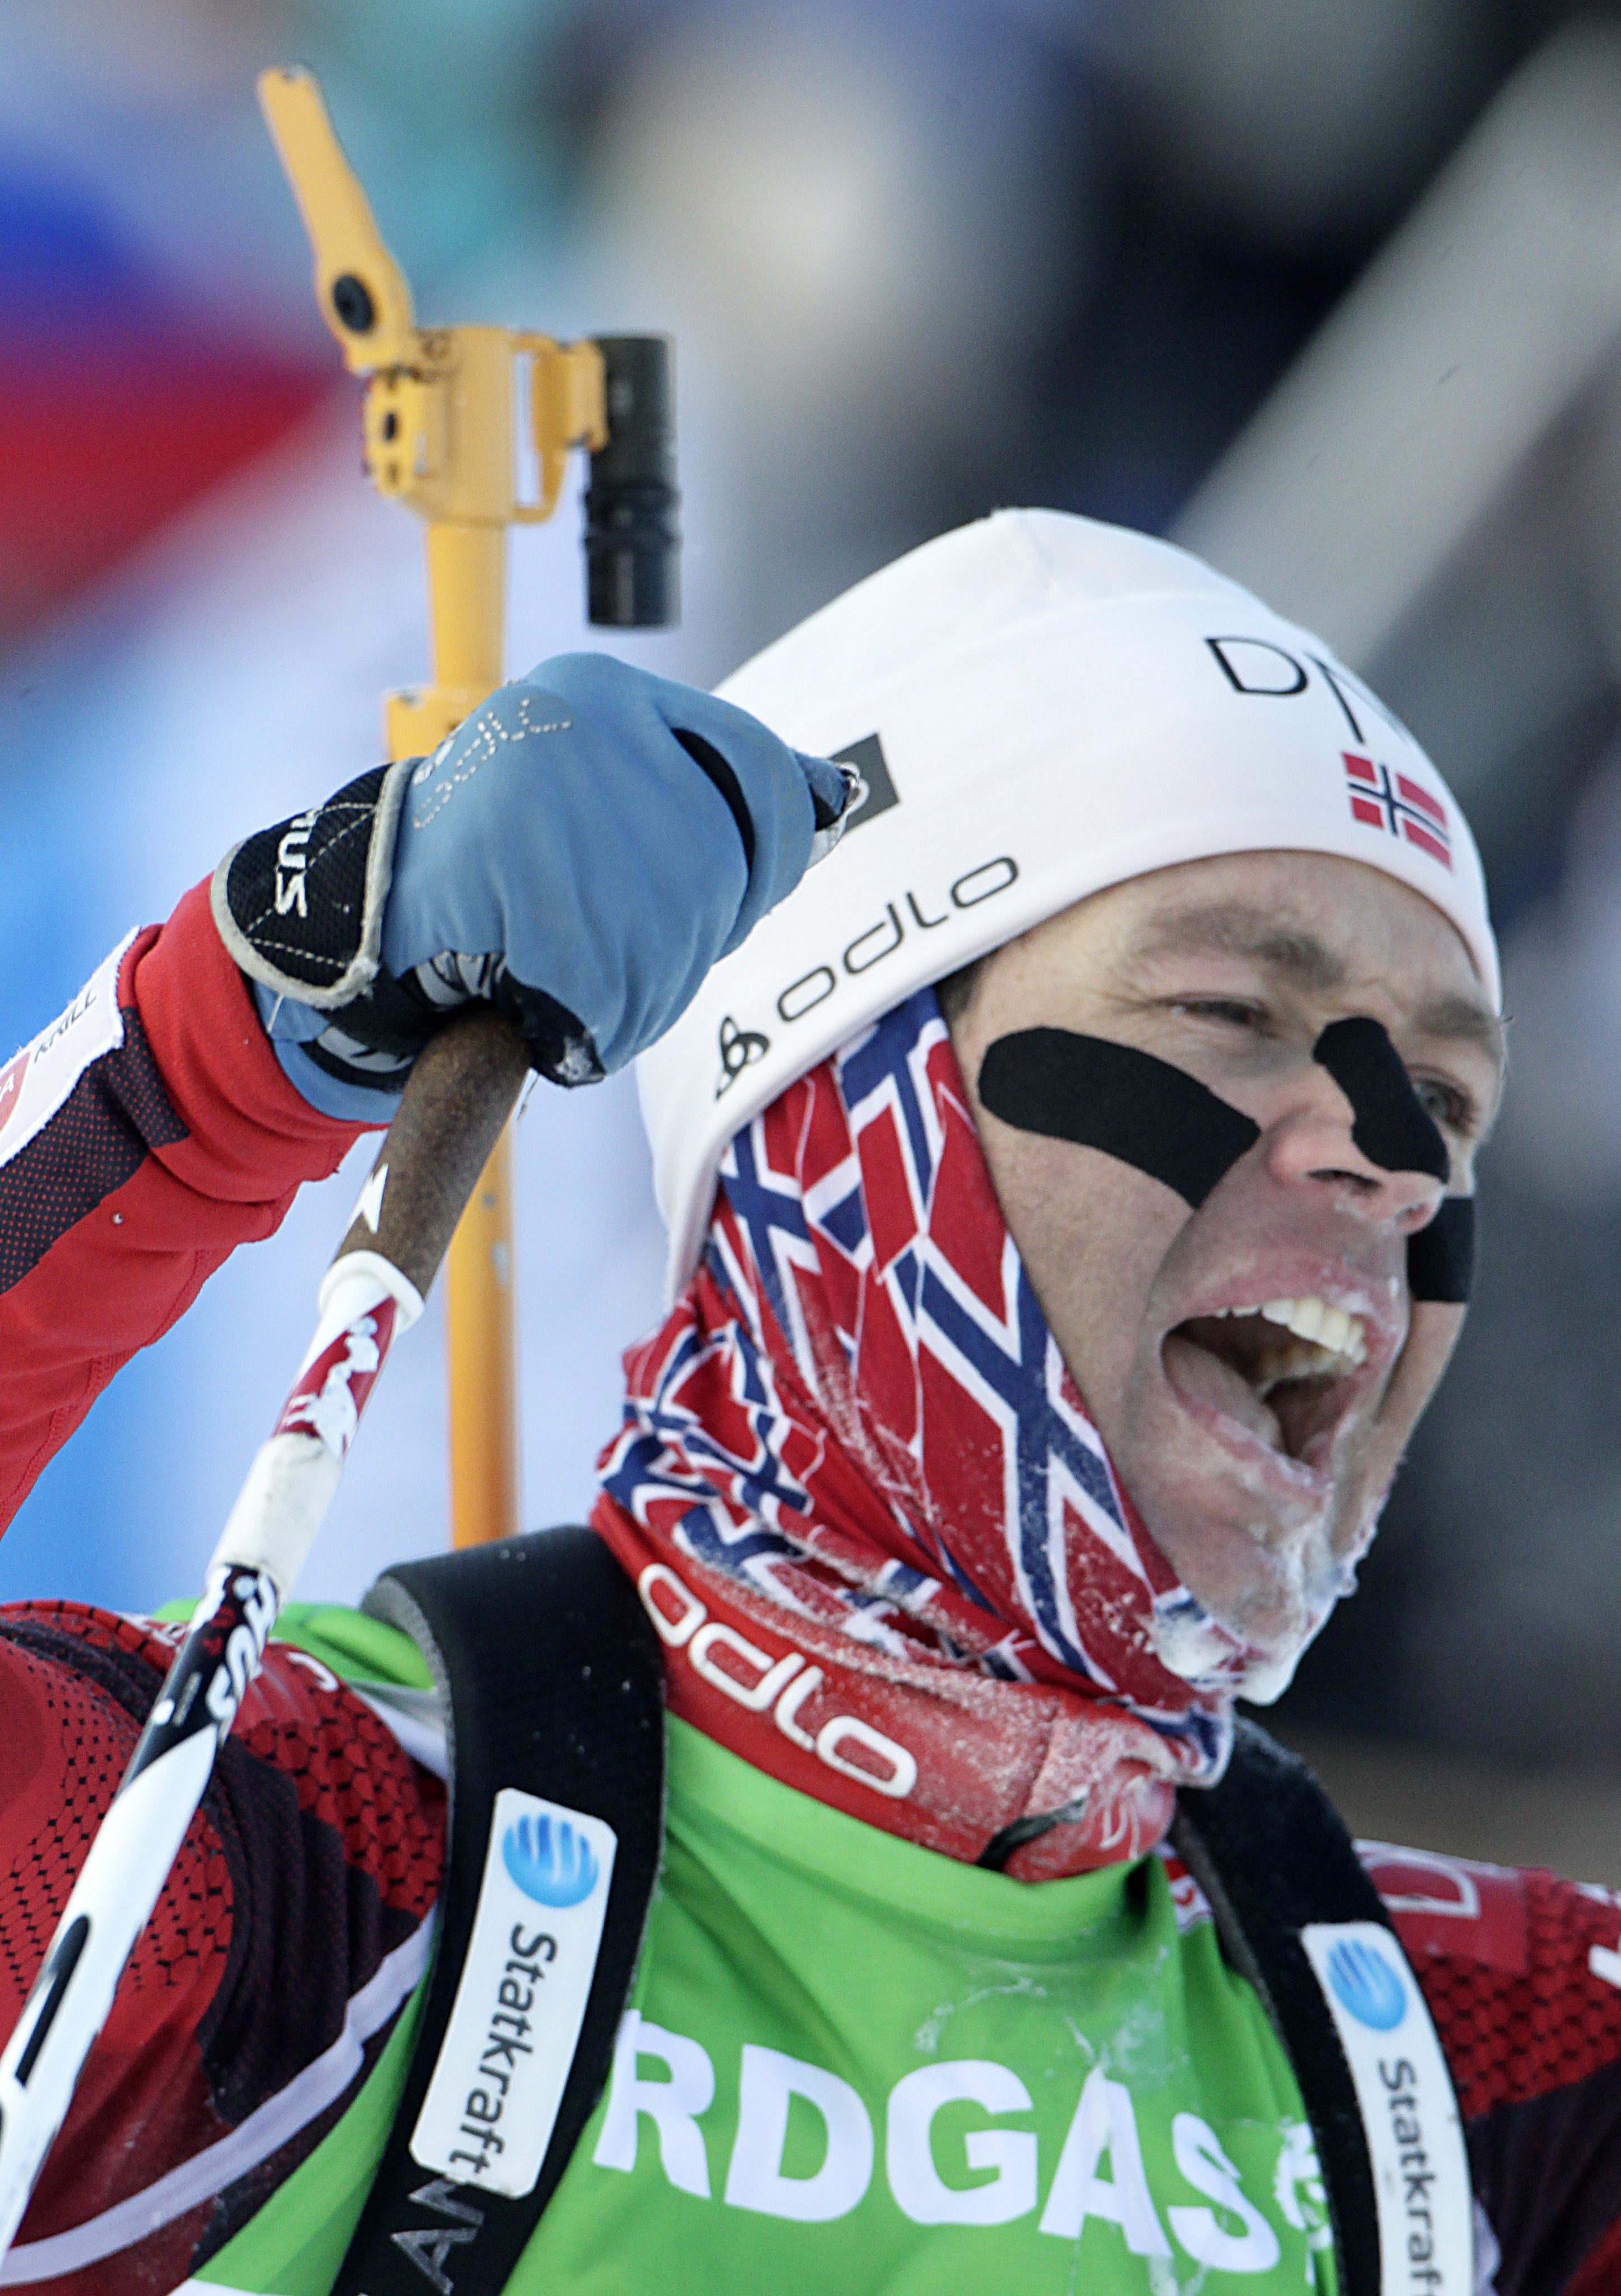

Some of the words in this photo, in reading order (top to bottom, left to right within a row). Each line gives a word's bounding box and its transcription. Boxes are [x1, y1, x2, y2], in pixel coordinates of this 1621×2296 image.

[777, 856, 1019, 1023] odlo
[637, 1563, 918, 1798] odlo
[449, 1922, 558, 2175] Statkraft
[1378, 2056, 1444, 2296] Statkraf
